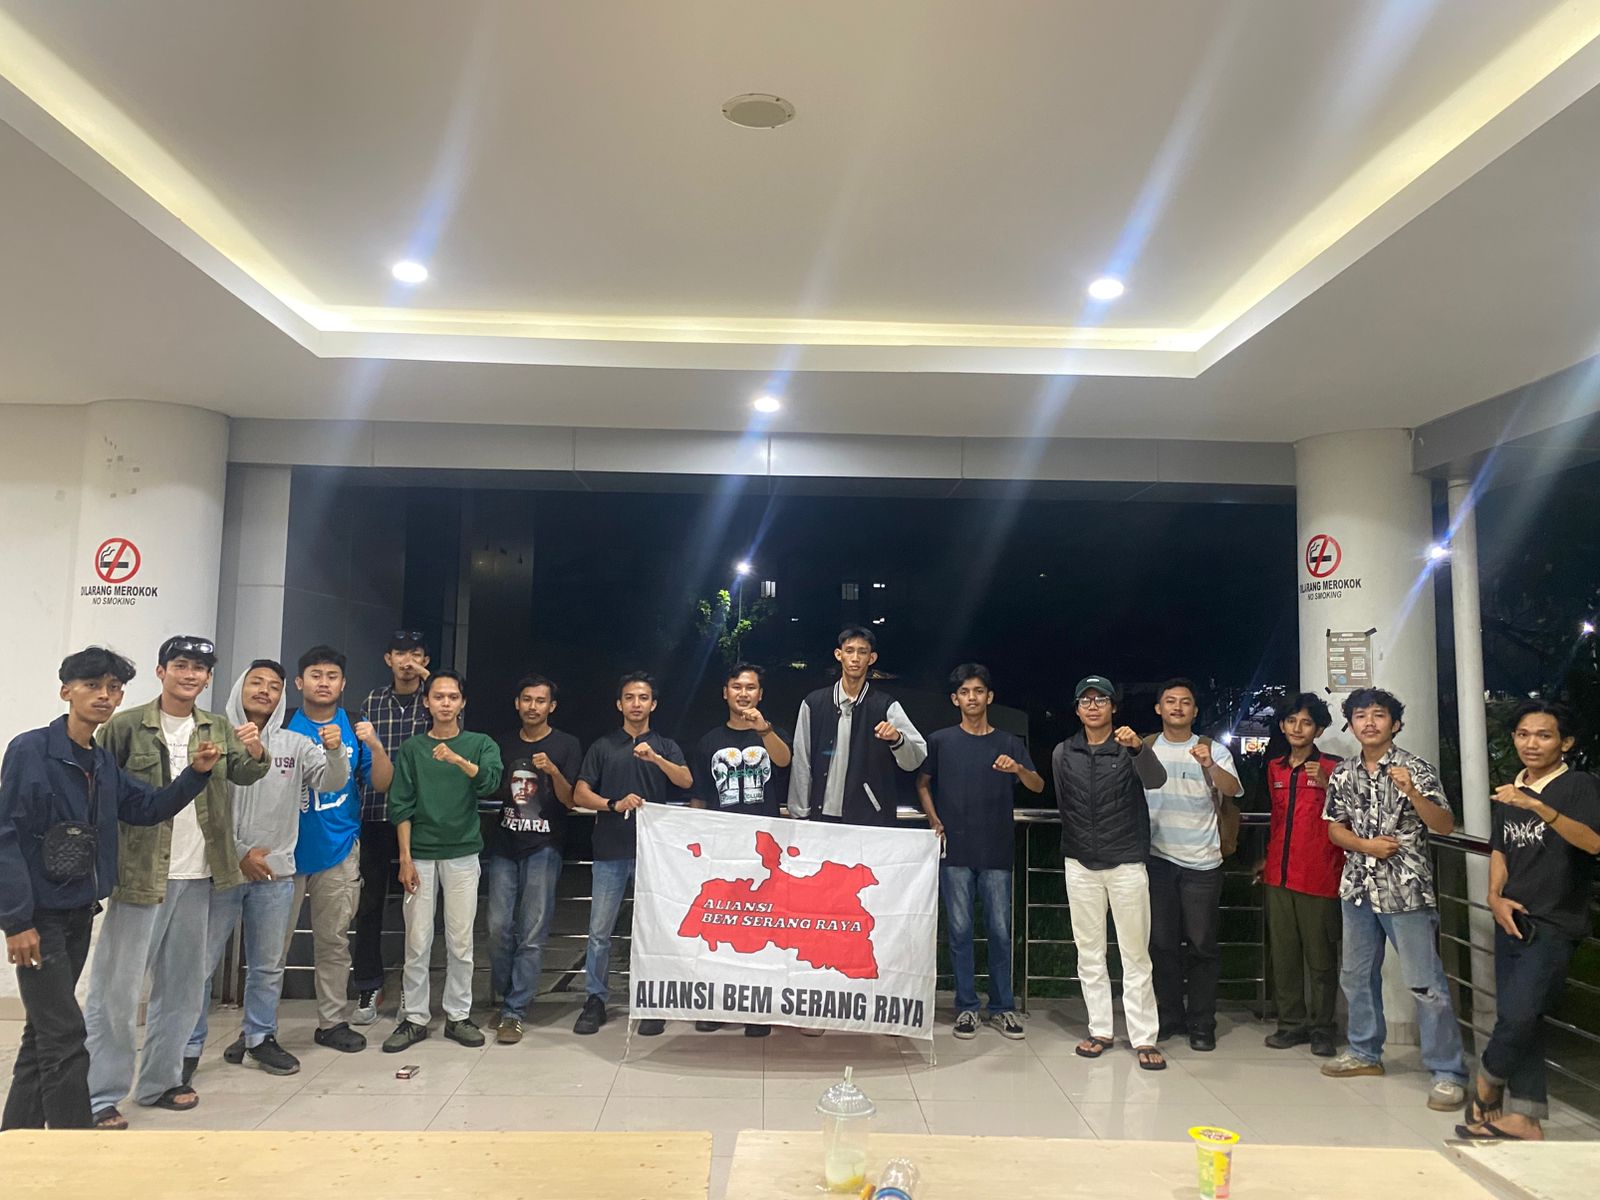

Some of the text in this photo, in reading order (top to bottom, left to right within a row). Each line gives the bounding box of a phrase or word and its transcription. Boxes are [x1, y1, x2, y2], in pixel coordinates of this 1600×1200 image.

[1322, 578, 1362, 590] MEROKOK
[80, 585, 158, 597] DILARANG MEROKOK
[1308, 590, 1342, 601] NO SMOKING
[92, 597, 136, 605] NO SMOKING
[274, 757, 296, 769] USA
[500, 816, 551, 833] UEVARA
[703, 898, 774, 913] ALIANSI
[701, 913, 862, 933] BEM SERANG RAYA
[636, 980, 924, 1029] ALIANSI BEM SERANG RAYA
